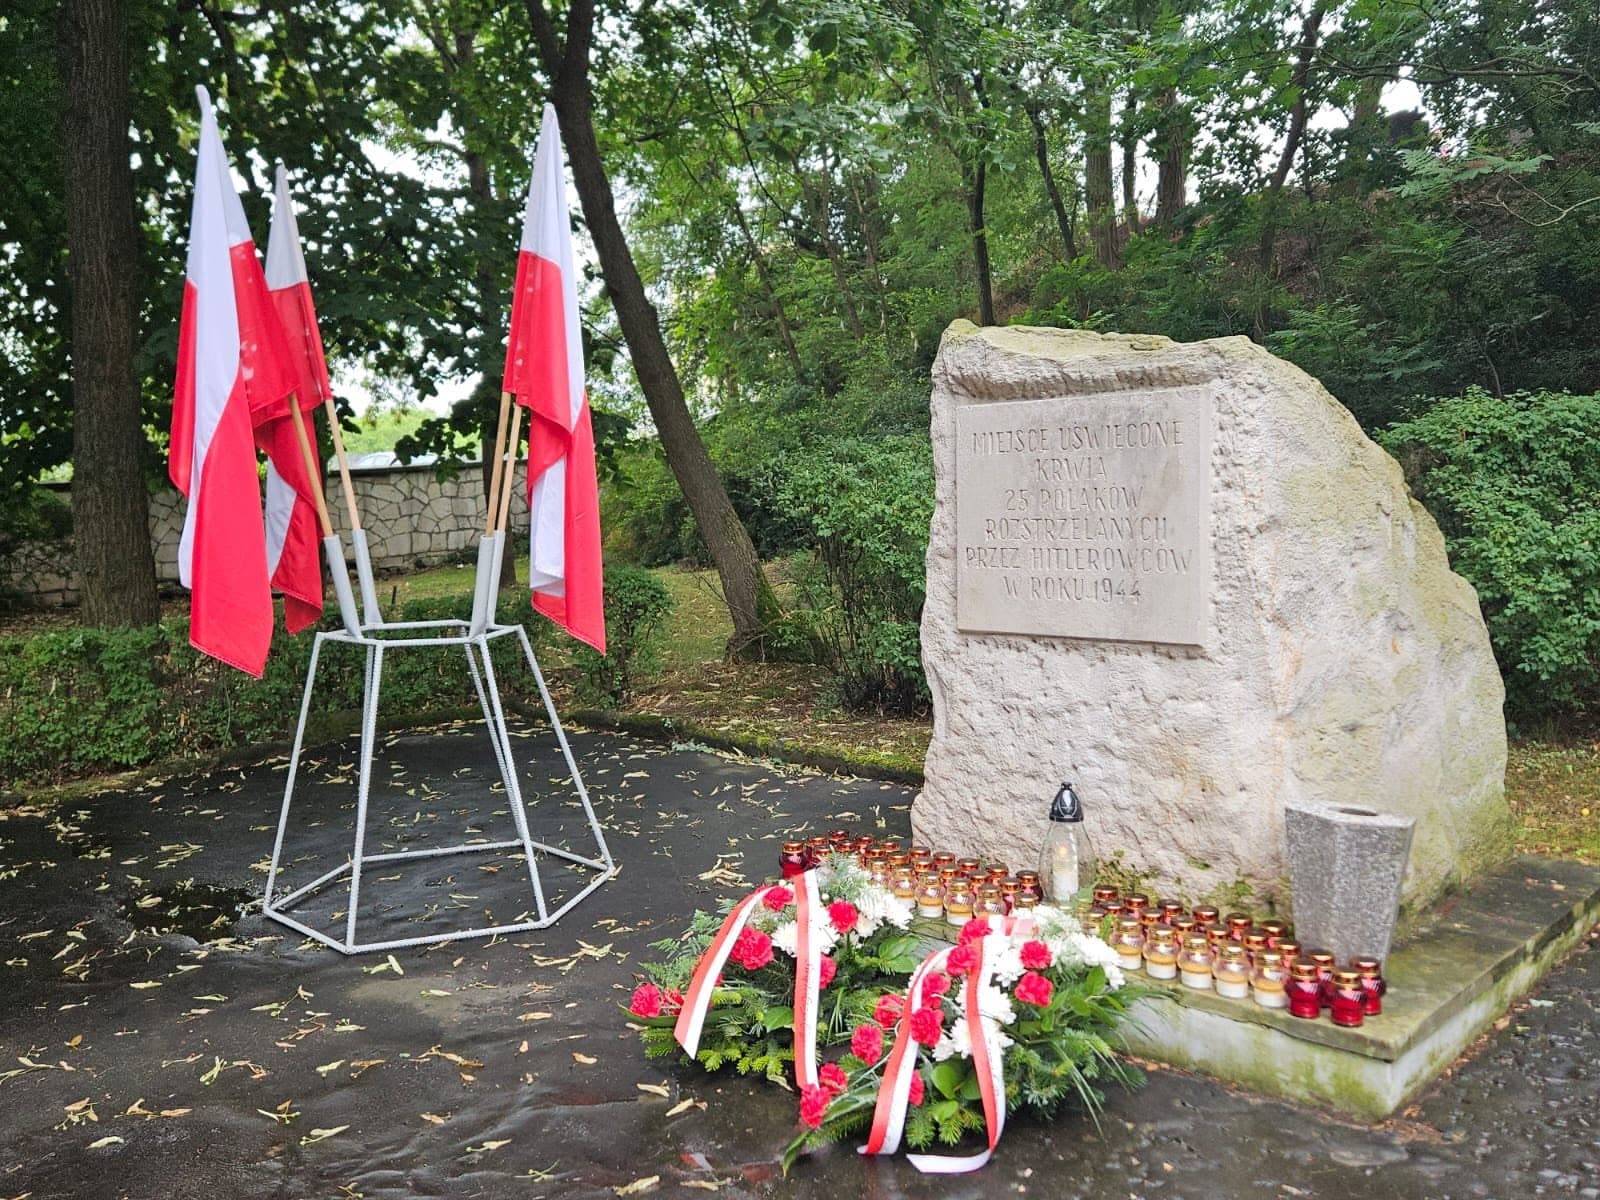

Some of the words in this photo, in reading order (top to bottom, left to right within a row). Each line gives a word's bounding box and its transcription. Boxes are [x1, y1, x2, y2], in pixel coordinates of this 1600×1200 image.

[972, 428, 1049, 455] MIEJSCE
[1004, 488, 1029, 512] 25
[1040, 483, 1144, 512] POLAKÓW
[984, 517, 1168, 543] ROZSTRZELANYCH
[965, 547, 1021, 570] PRZEZ
[1003, 576, 1022, 599] W
[1030, 577, 1085, 602] ROKU
[1093, 577, 1142, 604] 1944
